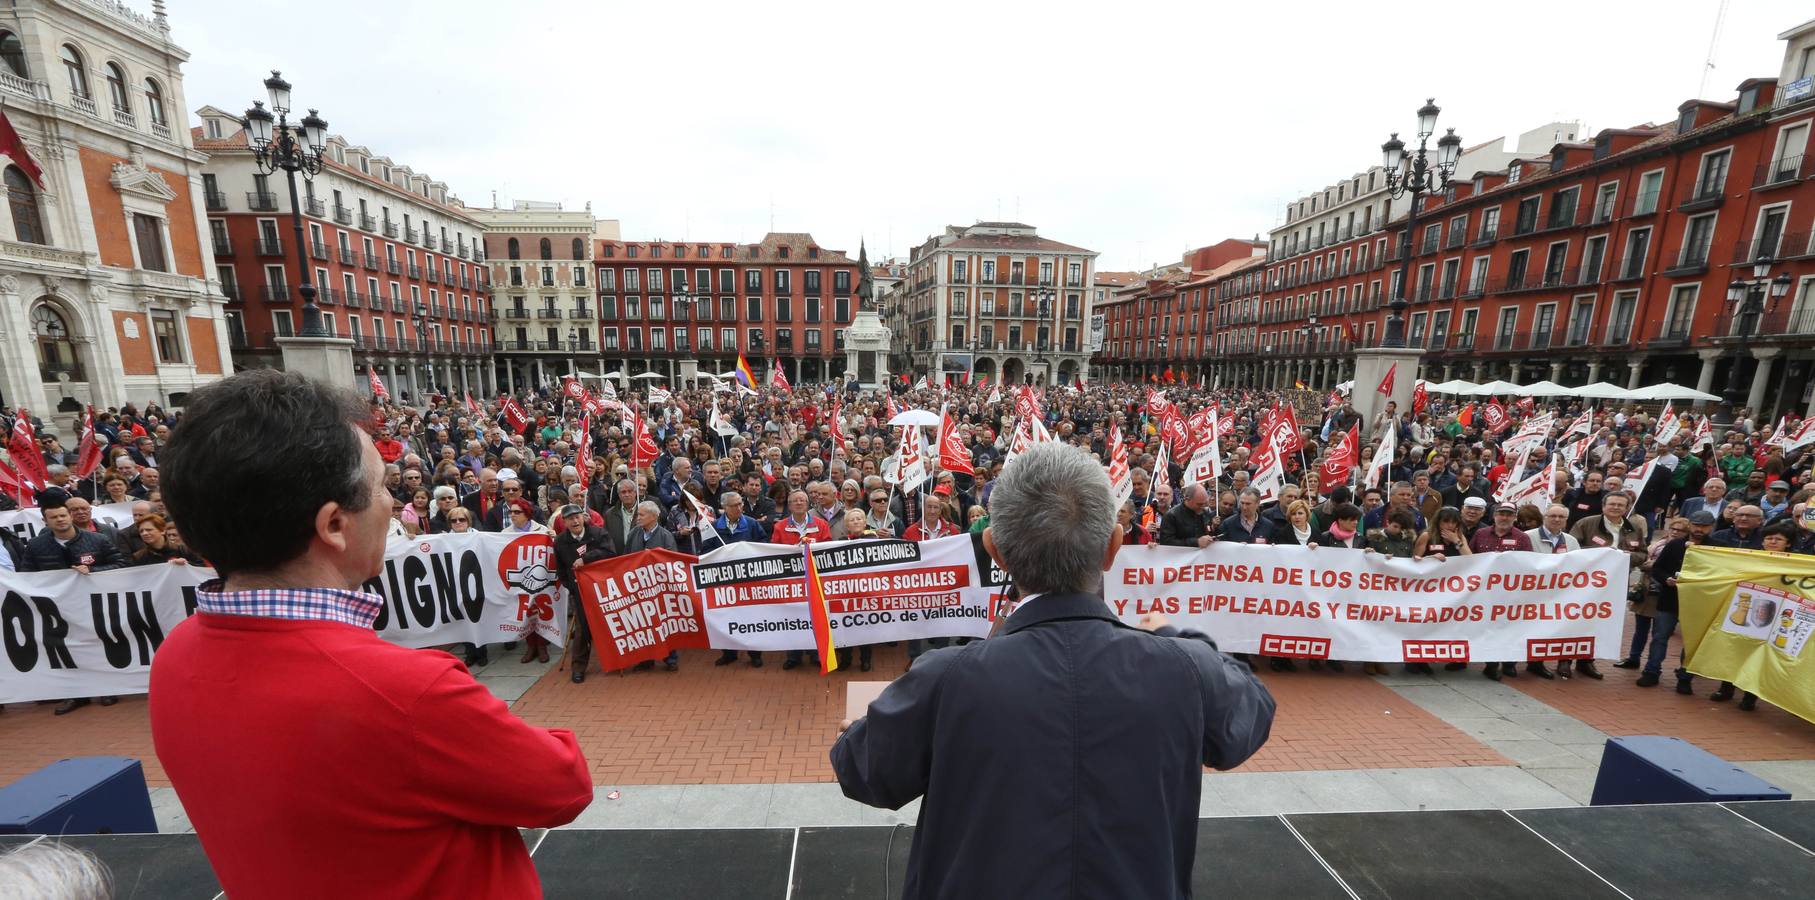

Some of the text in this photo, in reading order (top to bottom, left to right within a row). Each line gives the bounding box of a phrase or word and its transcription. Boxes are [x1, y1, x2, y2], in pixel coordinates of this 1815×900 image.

[508, 402, 526, 424] CCOO
[699, 565, 734, 584] EMPLEO
[734, 563, 747, 578] DE
[834, 551, 847, 566] DE
[848, 548, 864, 565] LAS
[866, 543, 916, 562] PENSIONES
[593, 561, 687, 603] LA CRISIS
[714, 586, 737, 606] NO
[740, 587, 750, 600] AL
[751, 585, 789, 600] RECORTE
[791, 583, 803, 597] DE
[824, 576, 890, 595] SERVICIOS
[893, 571, 956, 591] SOCIALES
[1123, 564, 1608, 592] EN DEFENSA DE LOS SERVICIOS PUBLICOS
[600, 582, 689, 613] TERMINA CUANDO HAYA
[841, 593, 957, 611] Y LAS PENSIONES
[1114, 595, 1612, 623] Y LAS EMPLEADAS Y EMPLEADOS PUBLICOS
[605, 593, 694, 638] EMPLEO
[842, 611, 895, 628] CC.OO.
[900, 611, 918, 622] de
[922, 605, 987, 620] Valladolid
[90, 591, 165, 669] UN
[615, 618, 699, 655] PARA TODOS
[1264, 638, 1326, 655] CCOO
[1406, 644, 1465, 658] CCOO
[1532, 641, 1591, 656] CCOO
